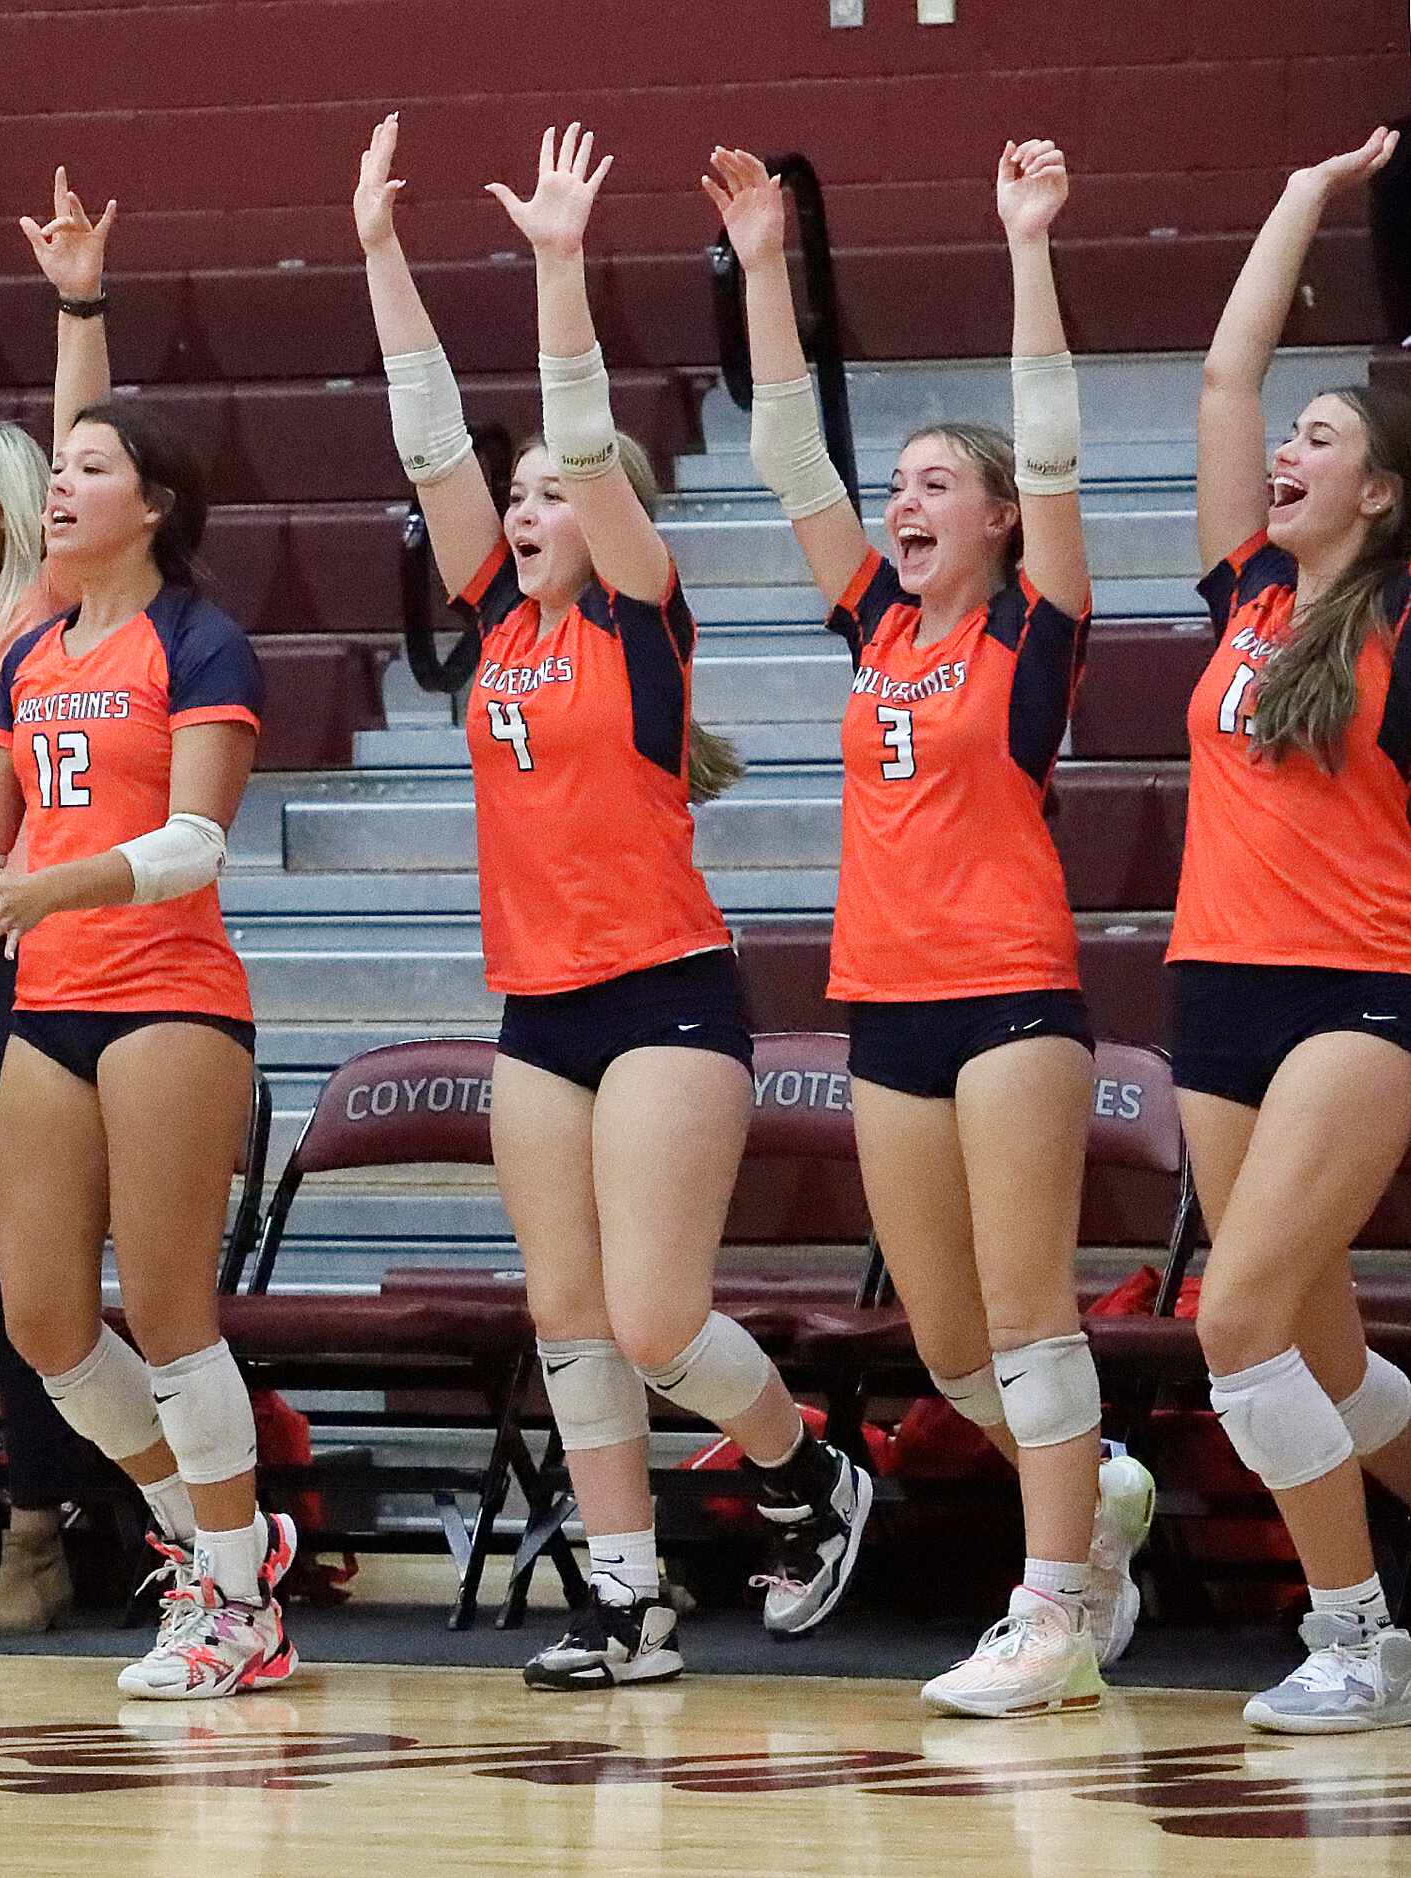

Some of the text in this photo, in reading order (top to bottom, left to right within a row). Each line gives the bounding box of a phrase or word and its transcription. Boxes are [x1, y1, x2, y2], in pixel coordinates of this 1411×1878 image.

[13, 690, 131, 725] WOLVERINES
[486, 700, 534, 771] 4
[877, 705, 916, 780] 3
[32, 731, 91, 808] 12
[754, 1070, 852, 1110] YOTE
[1094, 1079, 1142, 1119] ES
